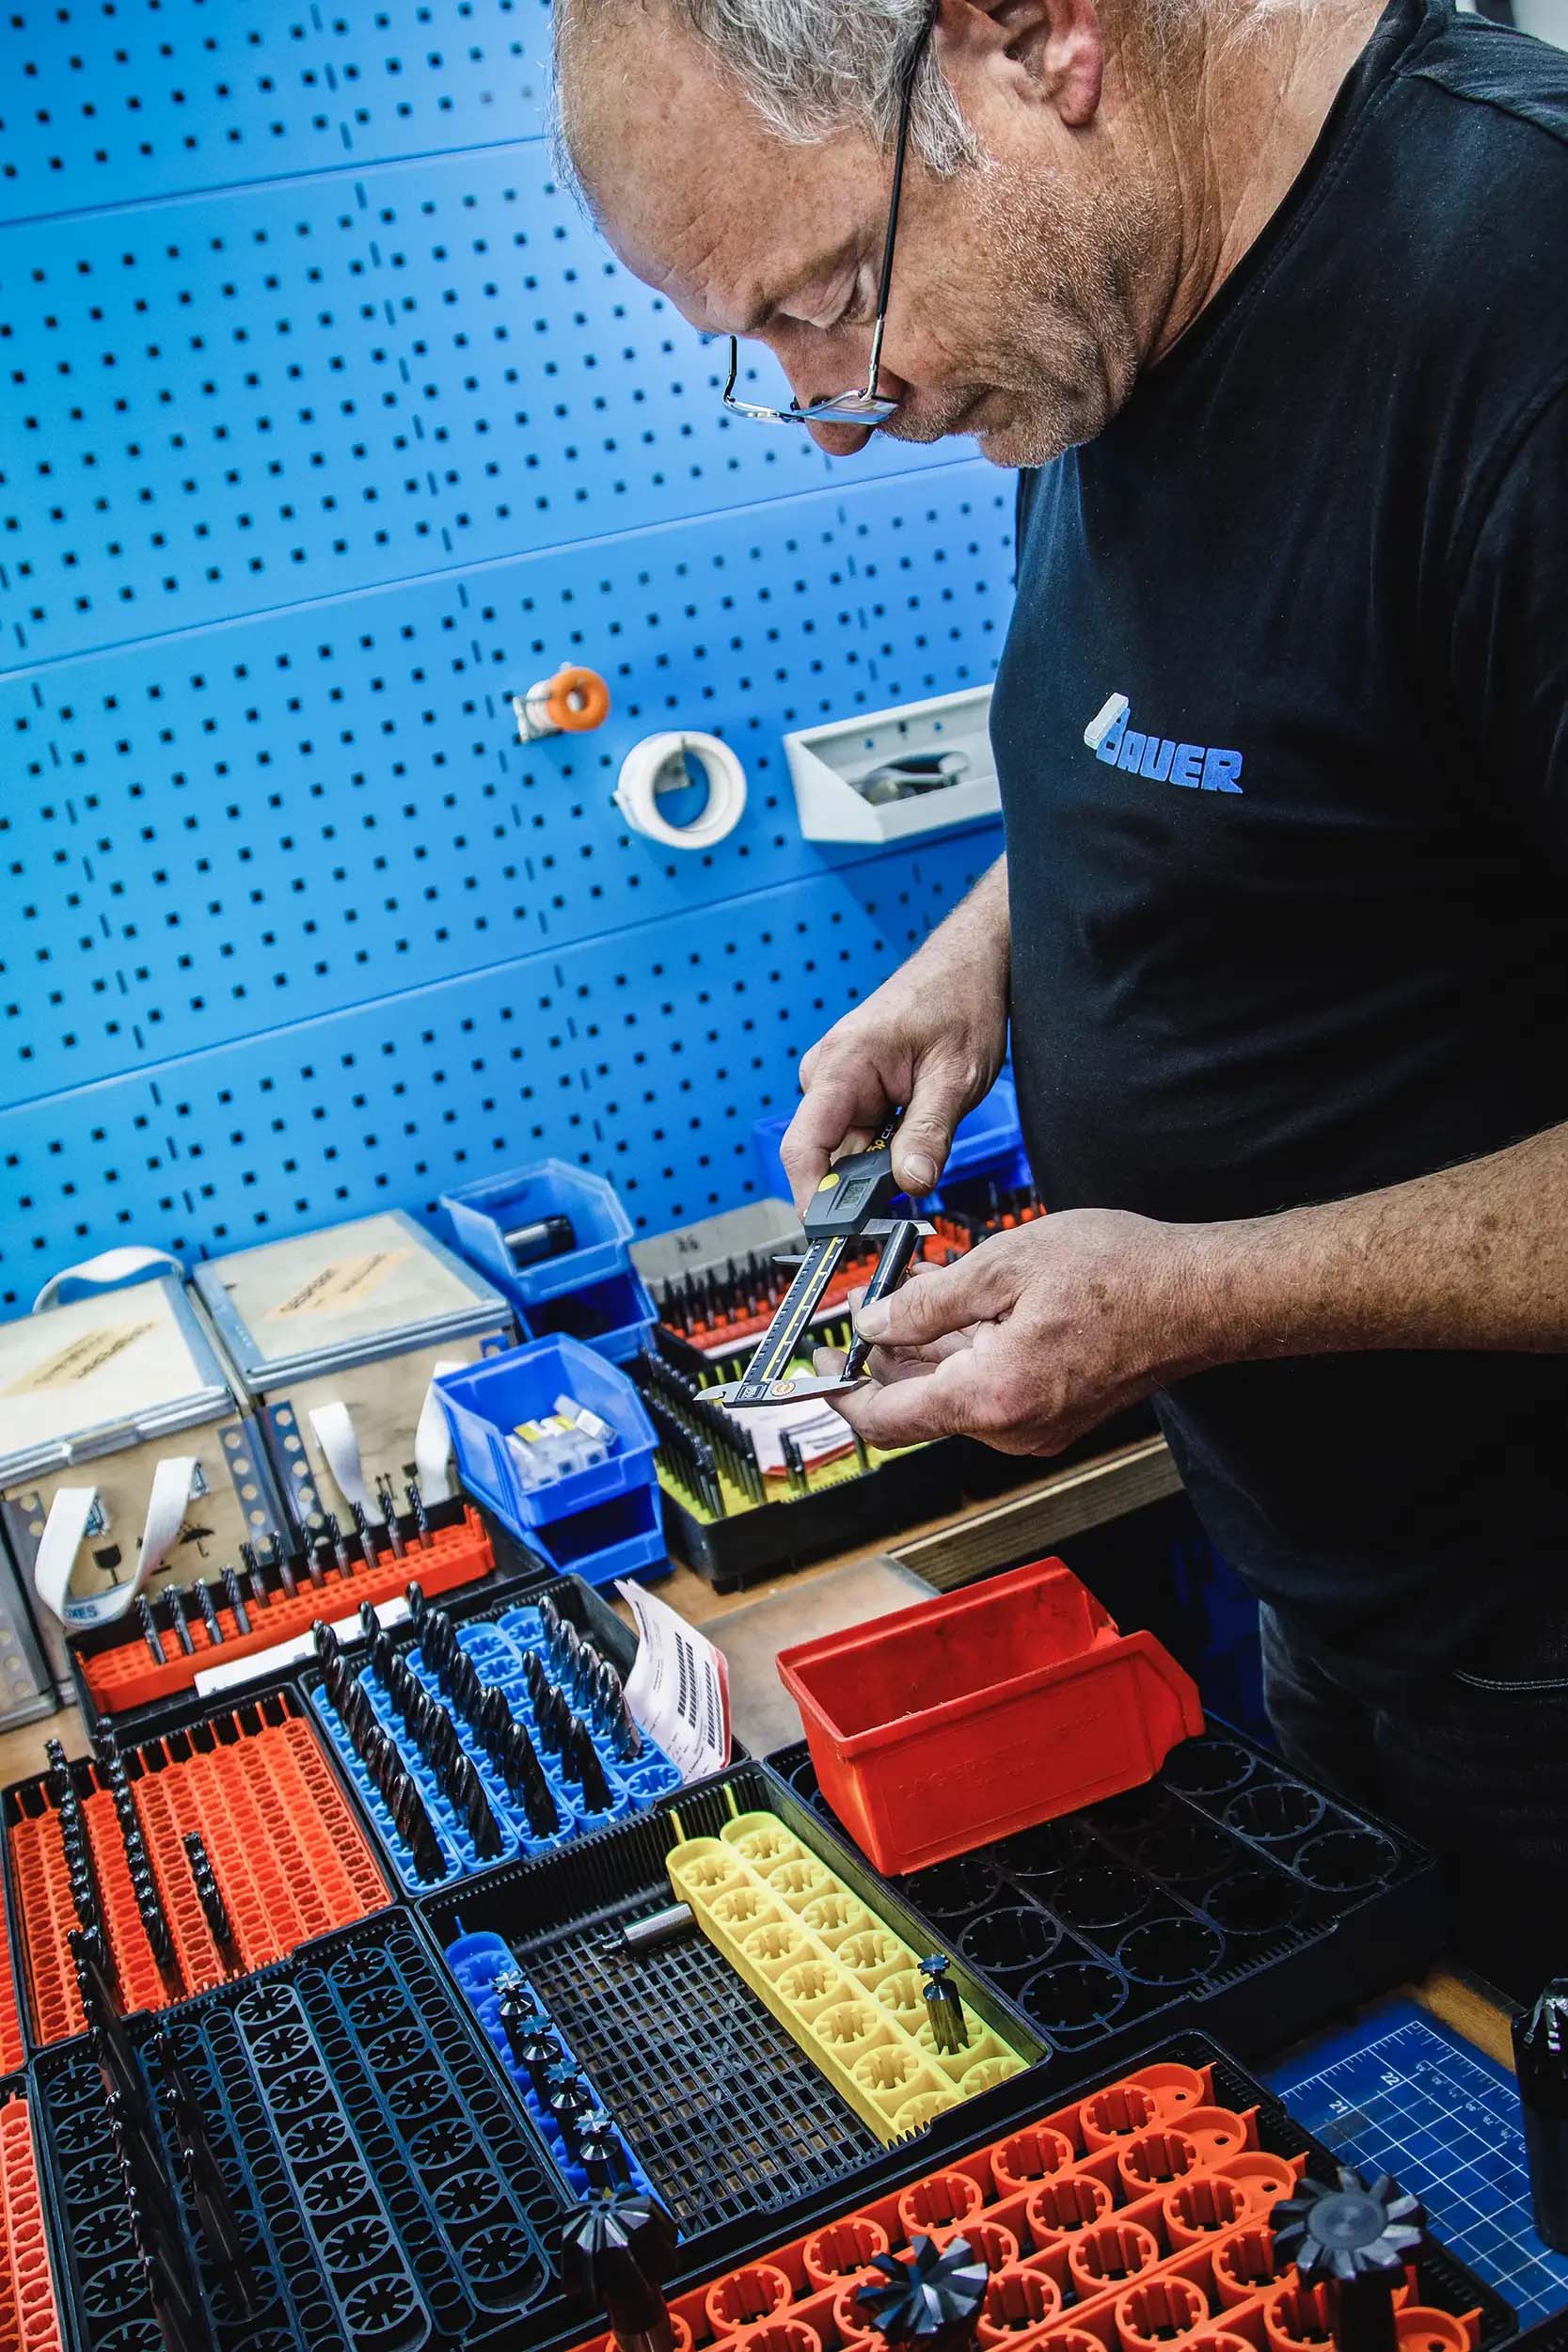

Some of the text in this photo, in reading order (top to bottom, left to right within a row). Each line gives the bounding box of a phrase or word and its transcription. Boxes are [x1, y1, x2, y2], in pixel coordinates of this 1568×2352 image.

[1085, 692, 1243, 794] BAUER
[1380, 2072, 1400, 2087] 22
[1328, 2100, 1348, 2114] 21
